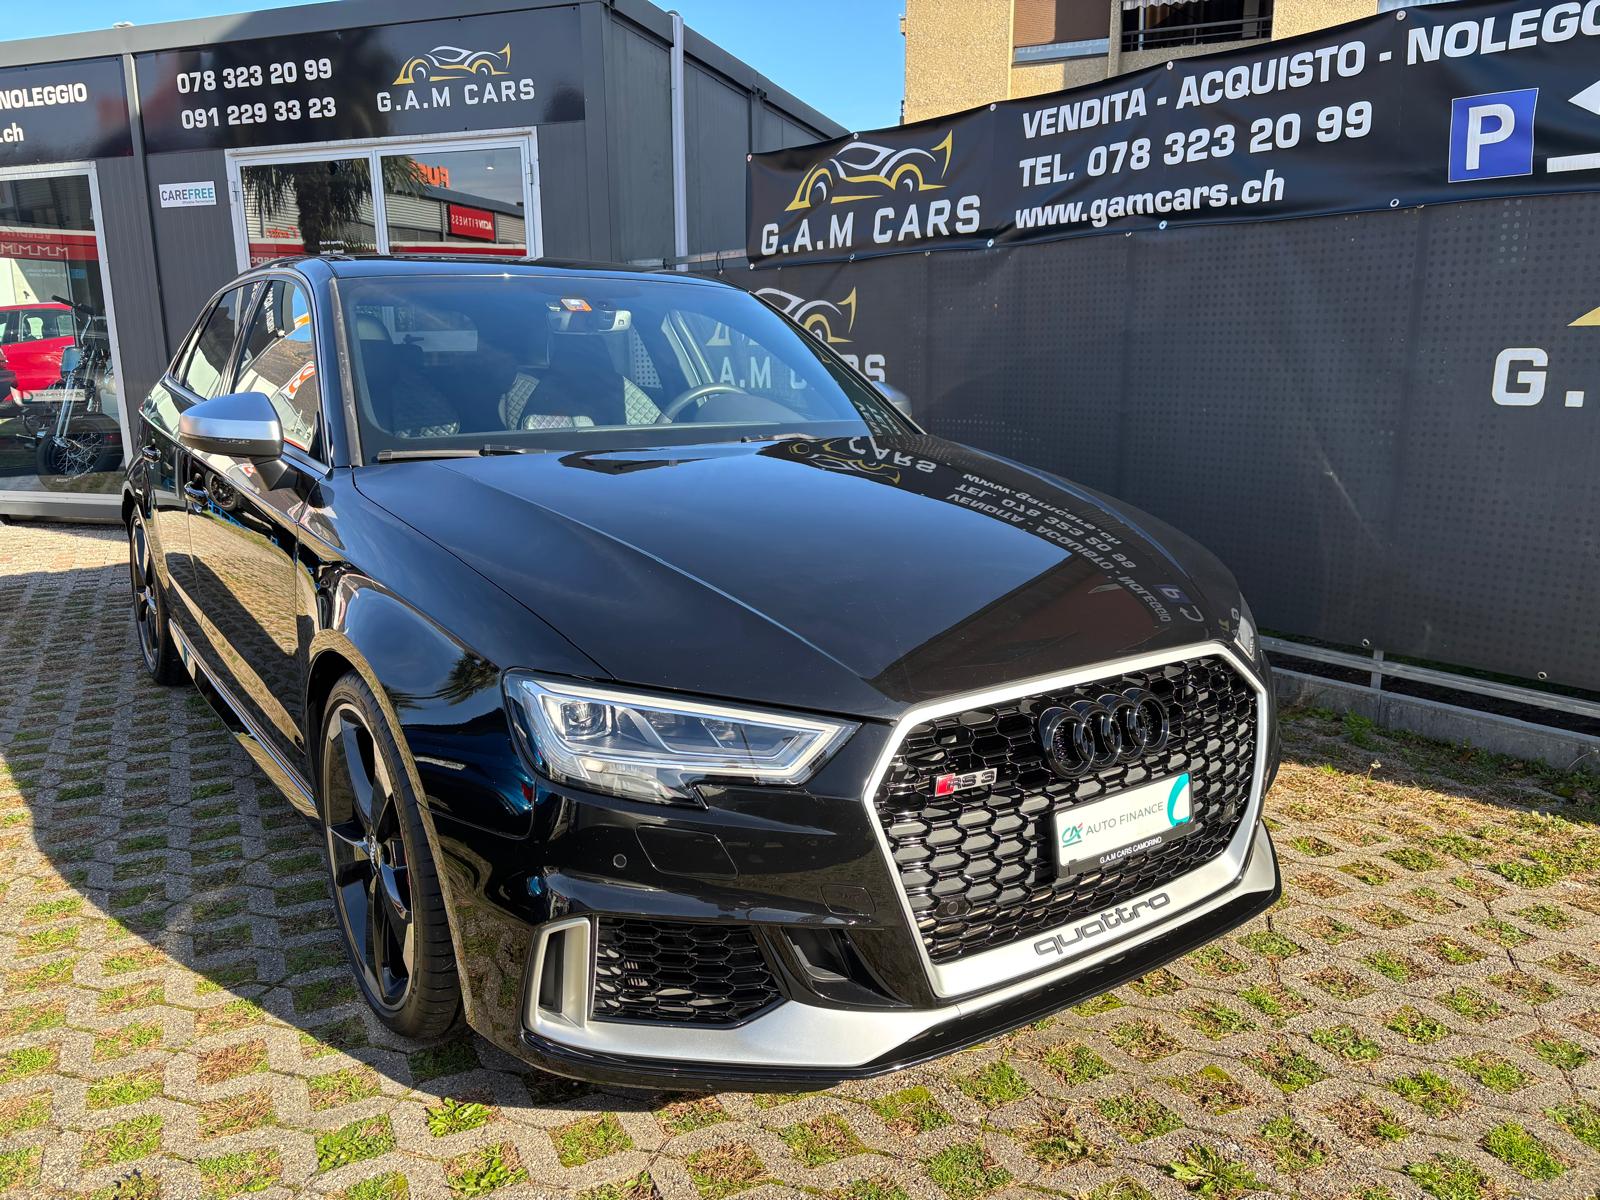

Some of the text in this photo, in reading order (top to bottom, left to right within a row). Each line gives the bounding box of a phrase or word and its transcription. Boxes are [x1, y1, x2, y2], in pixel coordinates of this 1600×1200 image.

[177, 57, 332, 94] 078 323 20 99
[1022, 87, 1147, 140] VENDITA
[1176, 40, 1366, 110] ACQUISTO
[0, 82, 88, 110] NOLEGGIO
[181, 96, 337, 130] 091 229 33 23
[376, 78, 535, 112] G.A.M CARS
[1019, 101, 1372, 188] TEL. 078 323 20 99
[1465, 103, 1516, 171] P
[161, 187, 215, 202] CAREFREE
[1015, 169, 1285, 229] www.gamcars.ch
[760, 194, 981, 256] G.A.M CARS
[1085, 818, 1117, 837] AUTO
[1119, 801, 1164, 825] FINANCE
[1100, 836, 1162, 864] G.A.M CARS CAMORINO
[1033, 892, 1171, 955] quattro
